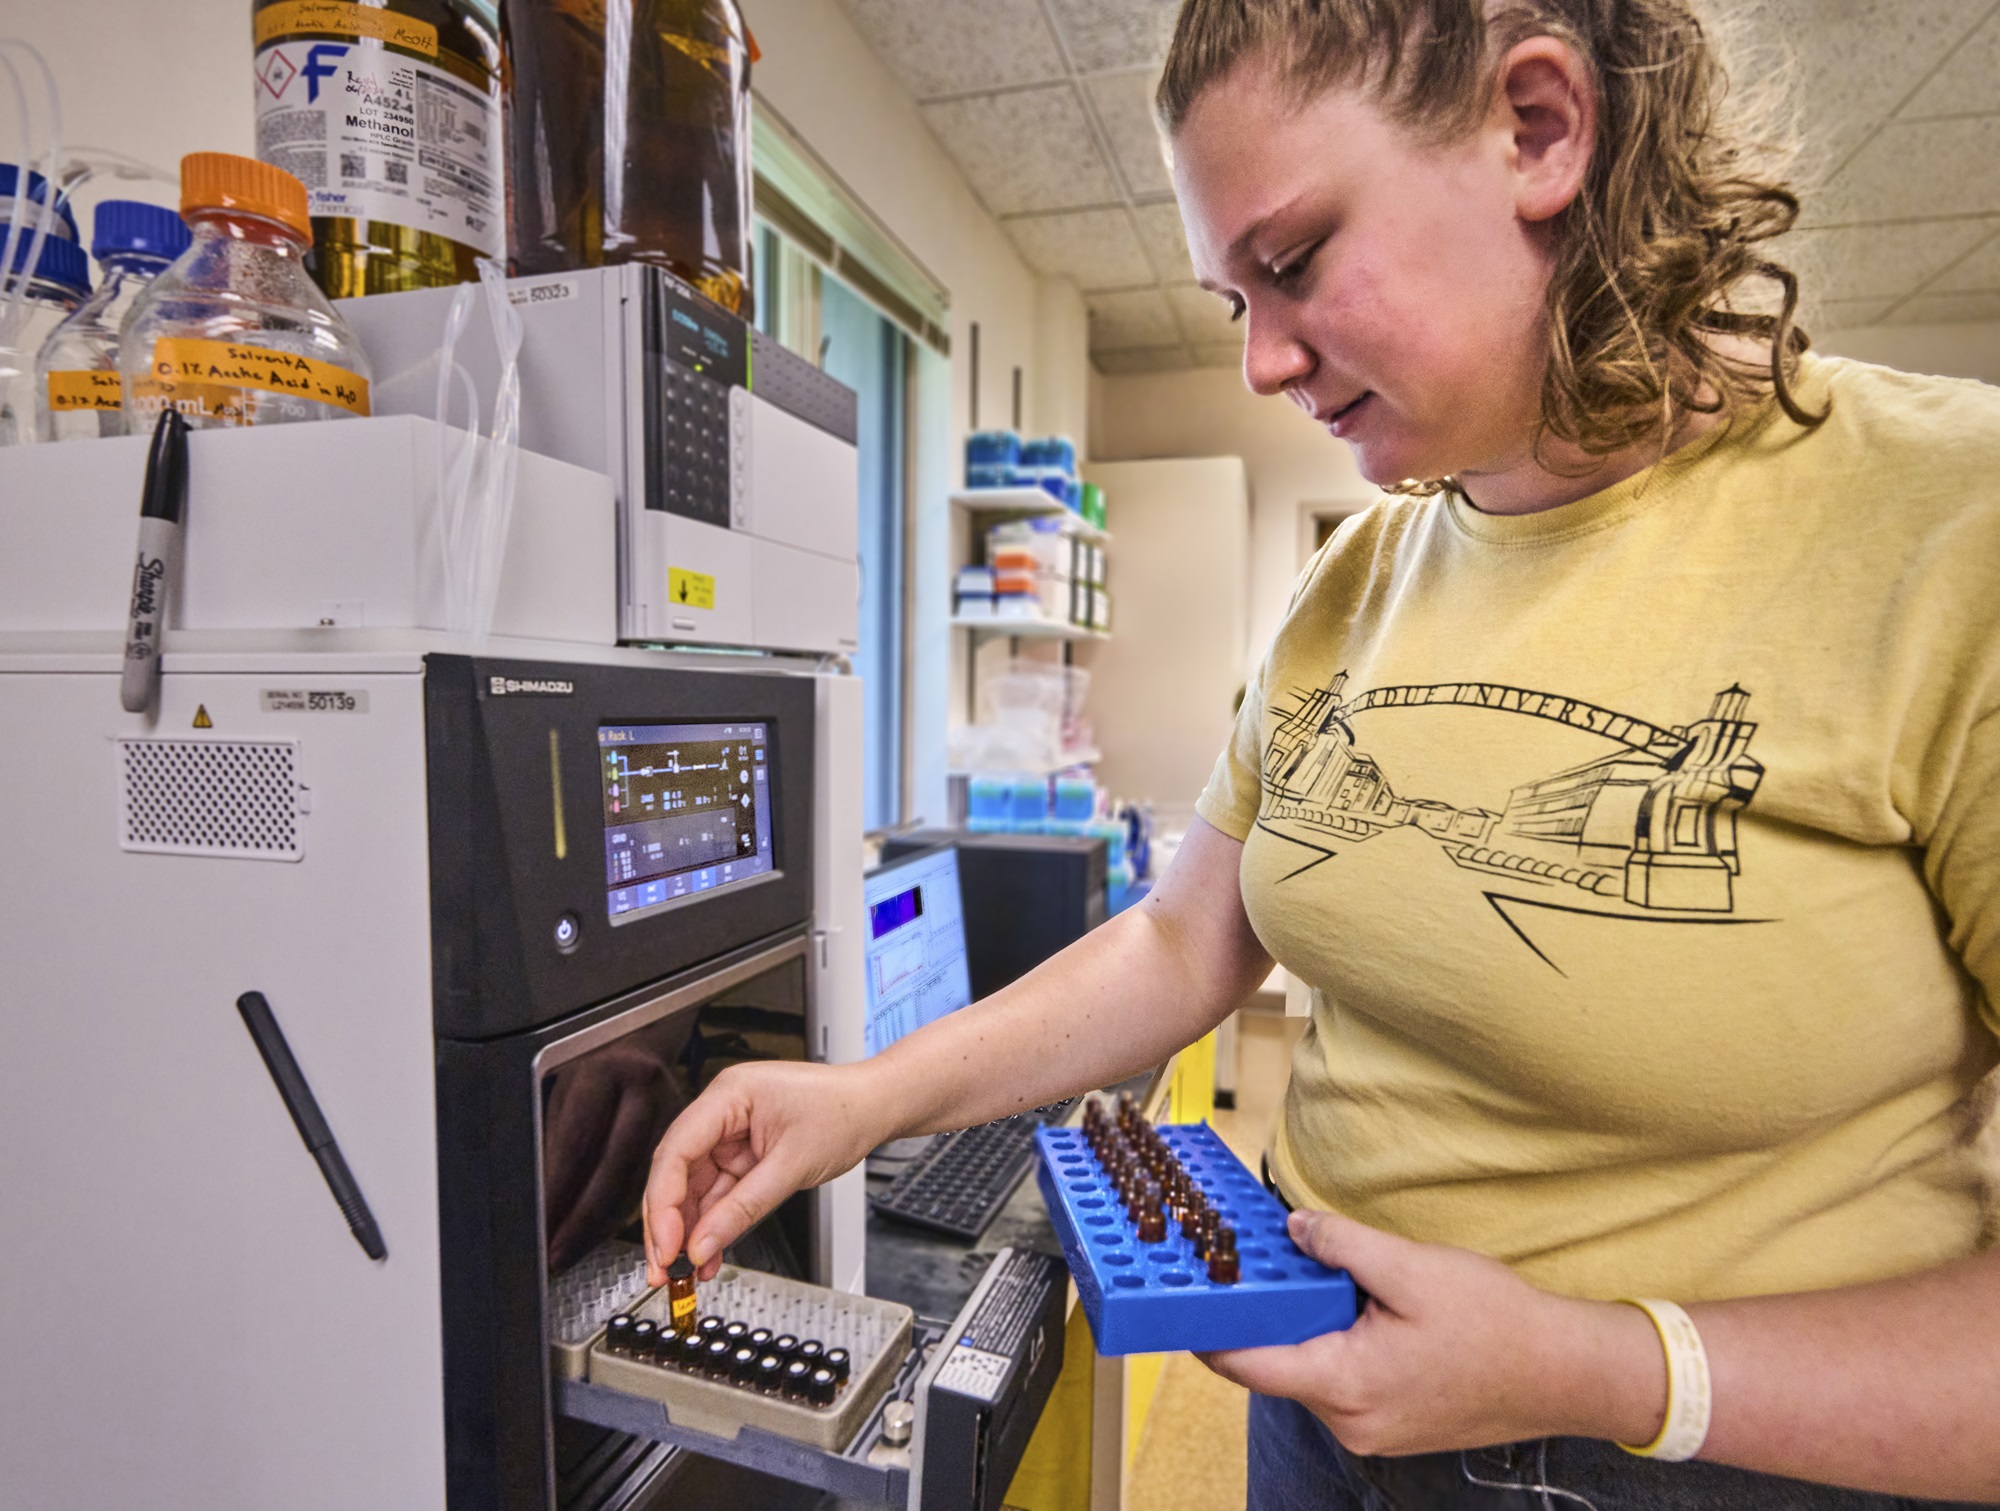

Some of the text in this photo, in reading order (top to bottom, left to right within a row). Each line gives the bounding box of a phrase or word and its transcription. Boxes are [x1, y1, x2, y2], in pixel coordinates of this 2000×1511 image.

[363, 94, 414, 115] A452-4
[360, 107, 414, 125] LOT 234950
[346, 115, 414, 139] Methanol
[370, 132, 392, 141] HPLC
[316, 191, 347, 203] fisher
[269, 371, 311, 390] Acid
[279, 402, 306, 418] 700
[136, 552, 165, 616] Sharpie
[506, 680, 573, 693] SHIMADZU
[308, 695, 355, 711] 50139
[1453, 683, 1668, 750] UNIVERSITY
